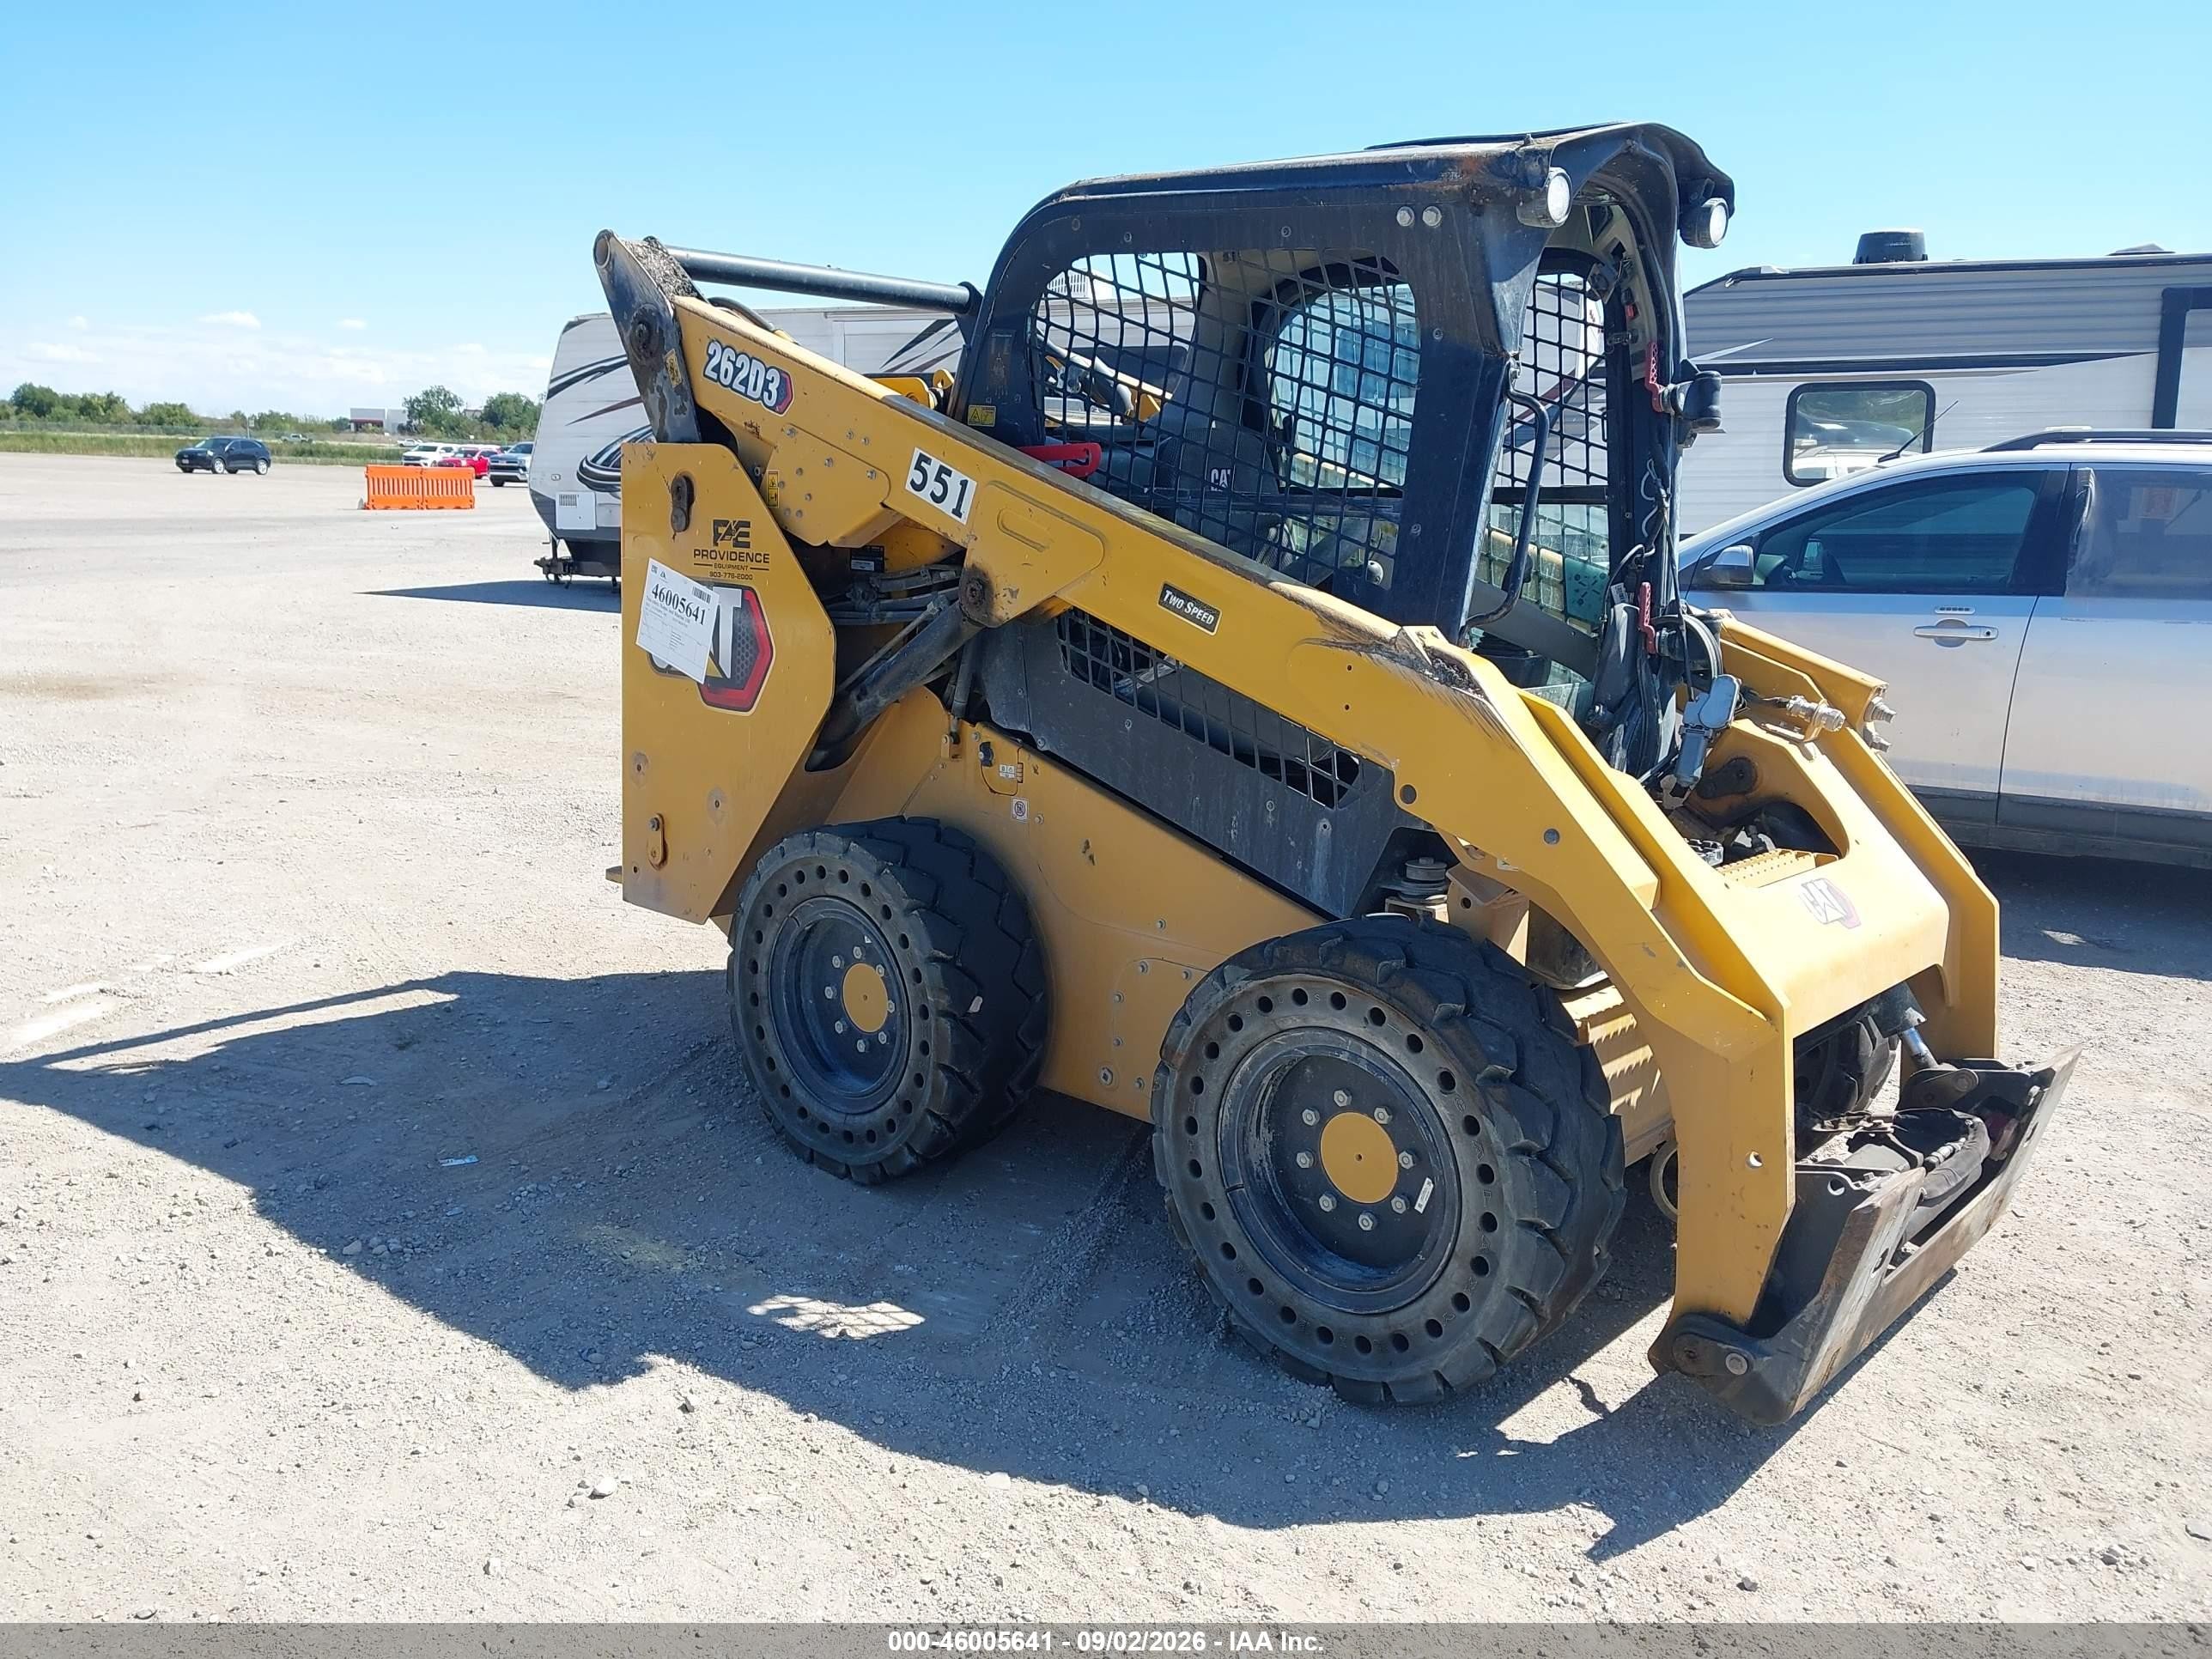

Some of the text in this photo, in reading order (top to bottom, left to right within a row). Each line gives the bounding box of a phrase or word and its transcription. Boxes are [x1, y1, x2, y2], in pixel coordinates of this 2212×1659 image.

[705, 340, 781, 410] 262D3
[909, 454, 968, 518] 551
[1211, 468, 1231, 492] CA
[693, 548, 770, 564] PROVIDENCE
[714, 562, 749, 571] EQUIPMENT
[651, 583, 707, 626] 46005641
